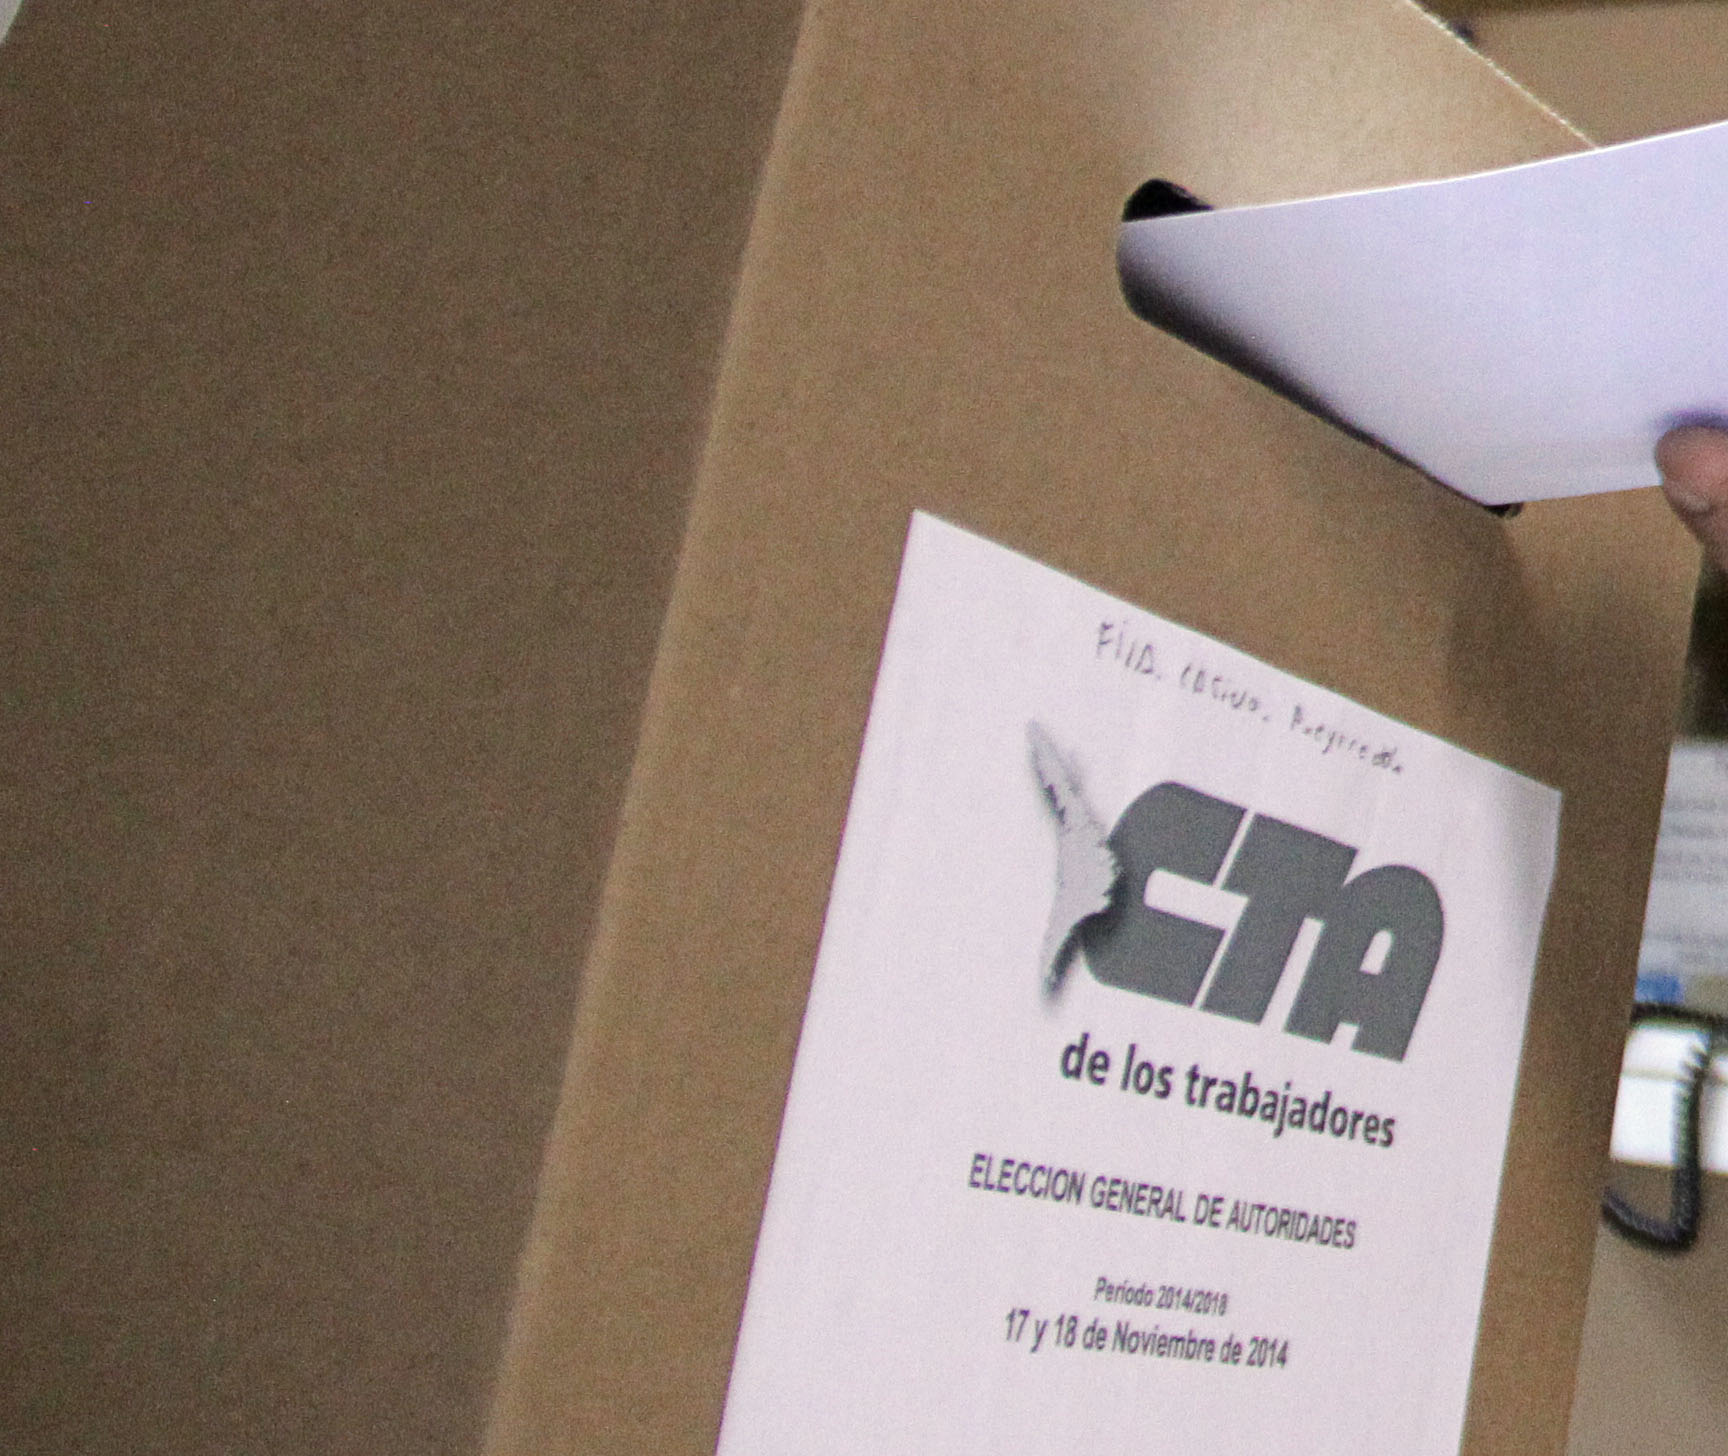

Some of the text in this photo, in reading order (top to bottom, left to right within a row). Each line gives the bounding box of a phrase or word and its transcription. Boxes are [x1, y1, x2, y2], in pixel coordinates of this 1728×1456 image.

[1082, 780, 1445, 1063] CTA
[1060, 1032, 1396, 1147] de los trabajadores
[968, 1153, 1357, 1250] ELECCION GENERAL DE AUTORIDADES
[1005, 1307, 1289, 1369] 17 y 18 de Noviembre de 2014
[1155, 1284, 1229, 1317] 2014/2018
